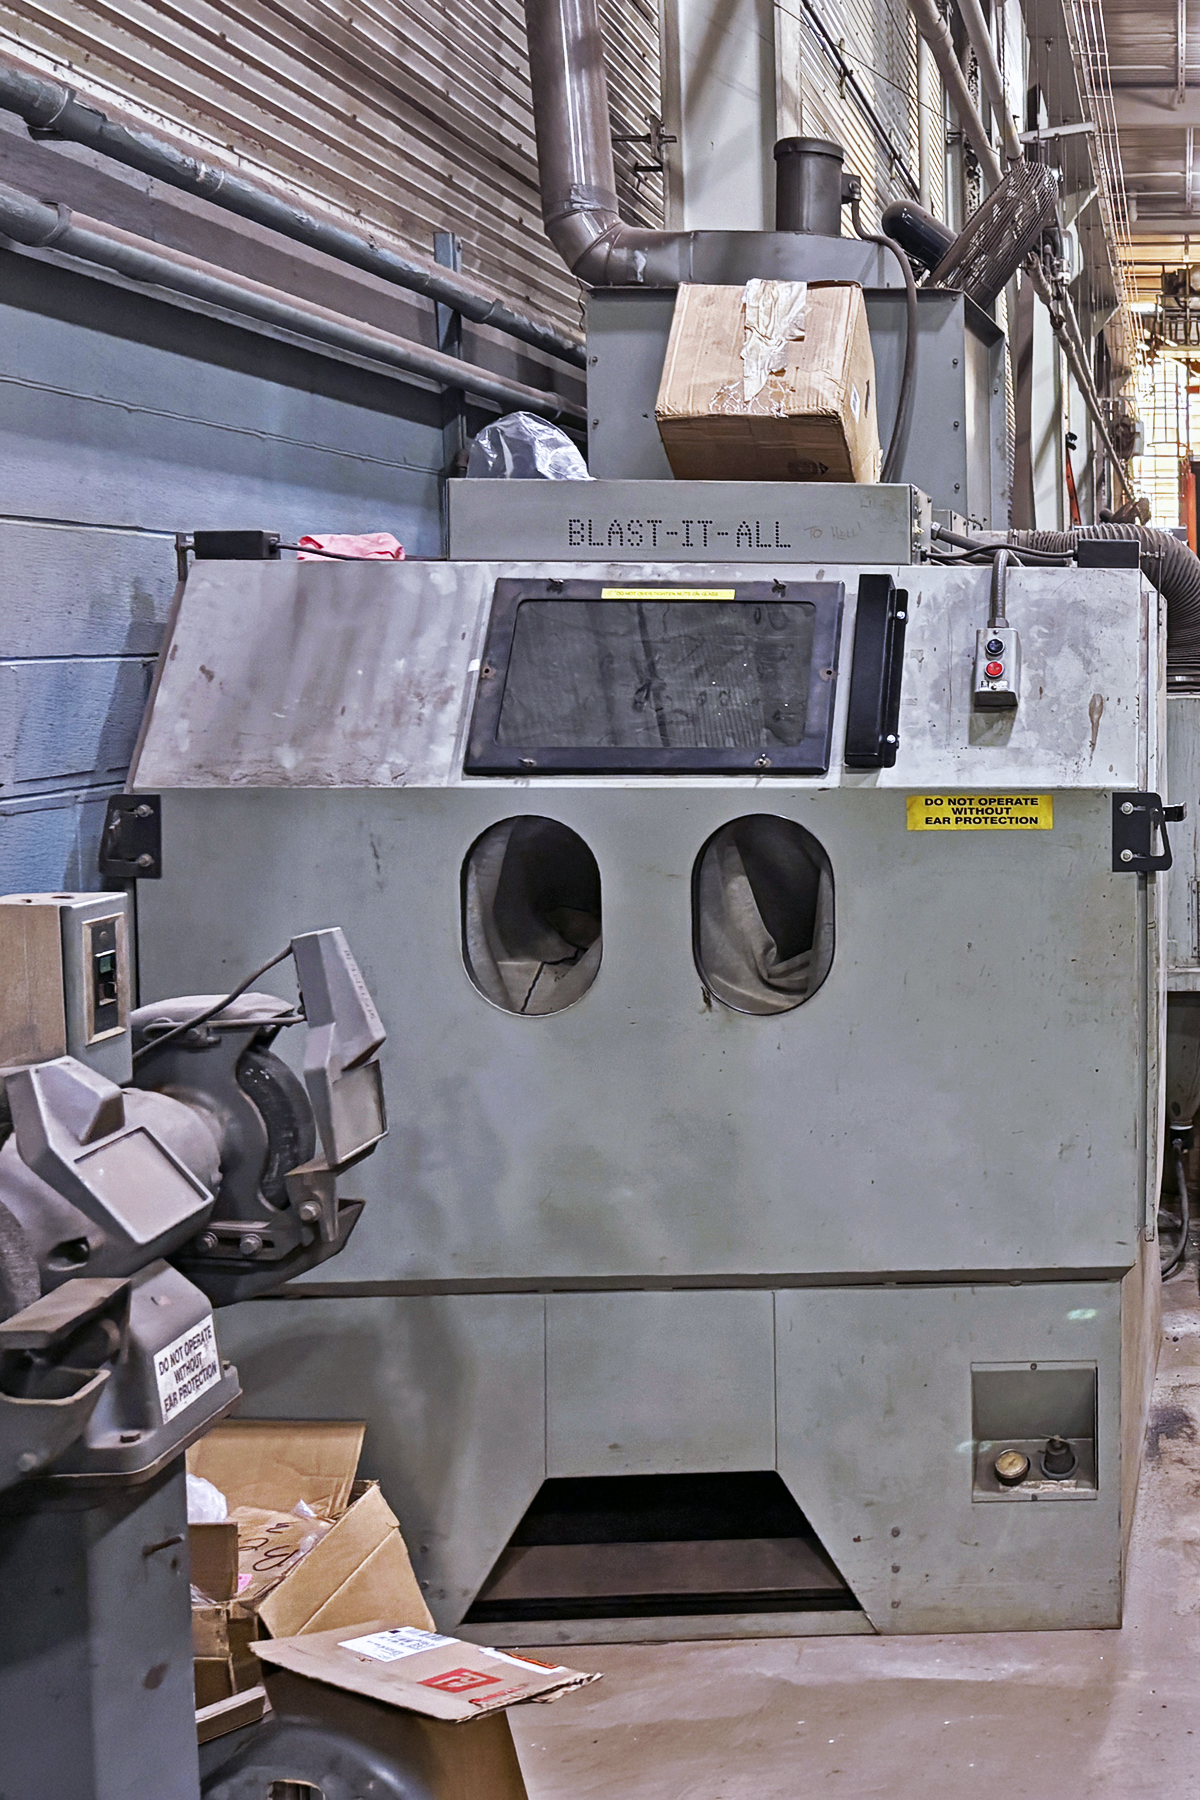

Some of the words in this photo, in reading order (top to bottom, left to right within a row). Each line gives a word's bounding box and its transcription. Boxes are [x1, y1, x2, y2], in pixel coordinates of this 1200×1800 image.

[567, 518, 792, 548] BLAST-IT-ALL
[925, 798, 944, 806] DO
[947, 798, 975, 806] NOT
[978, 798, 1039, 806] OPERATE
[952, 807, 1012, 815] WITHOUT
[925, 816, 951, 825] EAR
[955, 816, 1039, 825] PROTECTION
[158, 1357, 170, 1376] DO
[169, 1346, 183, 1368] NOT
[184, 1325, 212, 1356] OPERATE
[173, 1352, 202, 1384] WITHOUT
[163, 1391, 179, 1413] EAR
[178, 1360, 218, 1400] PROTECTION
